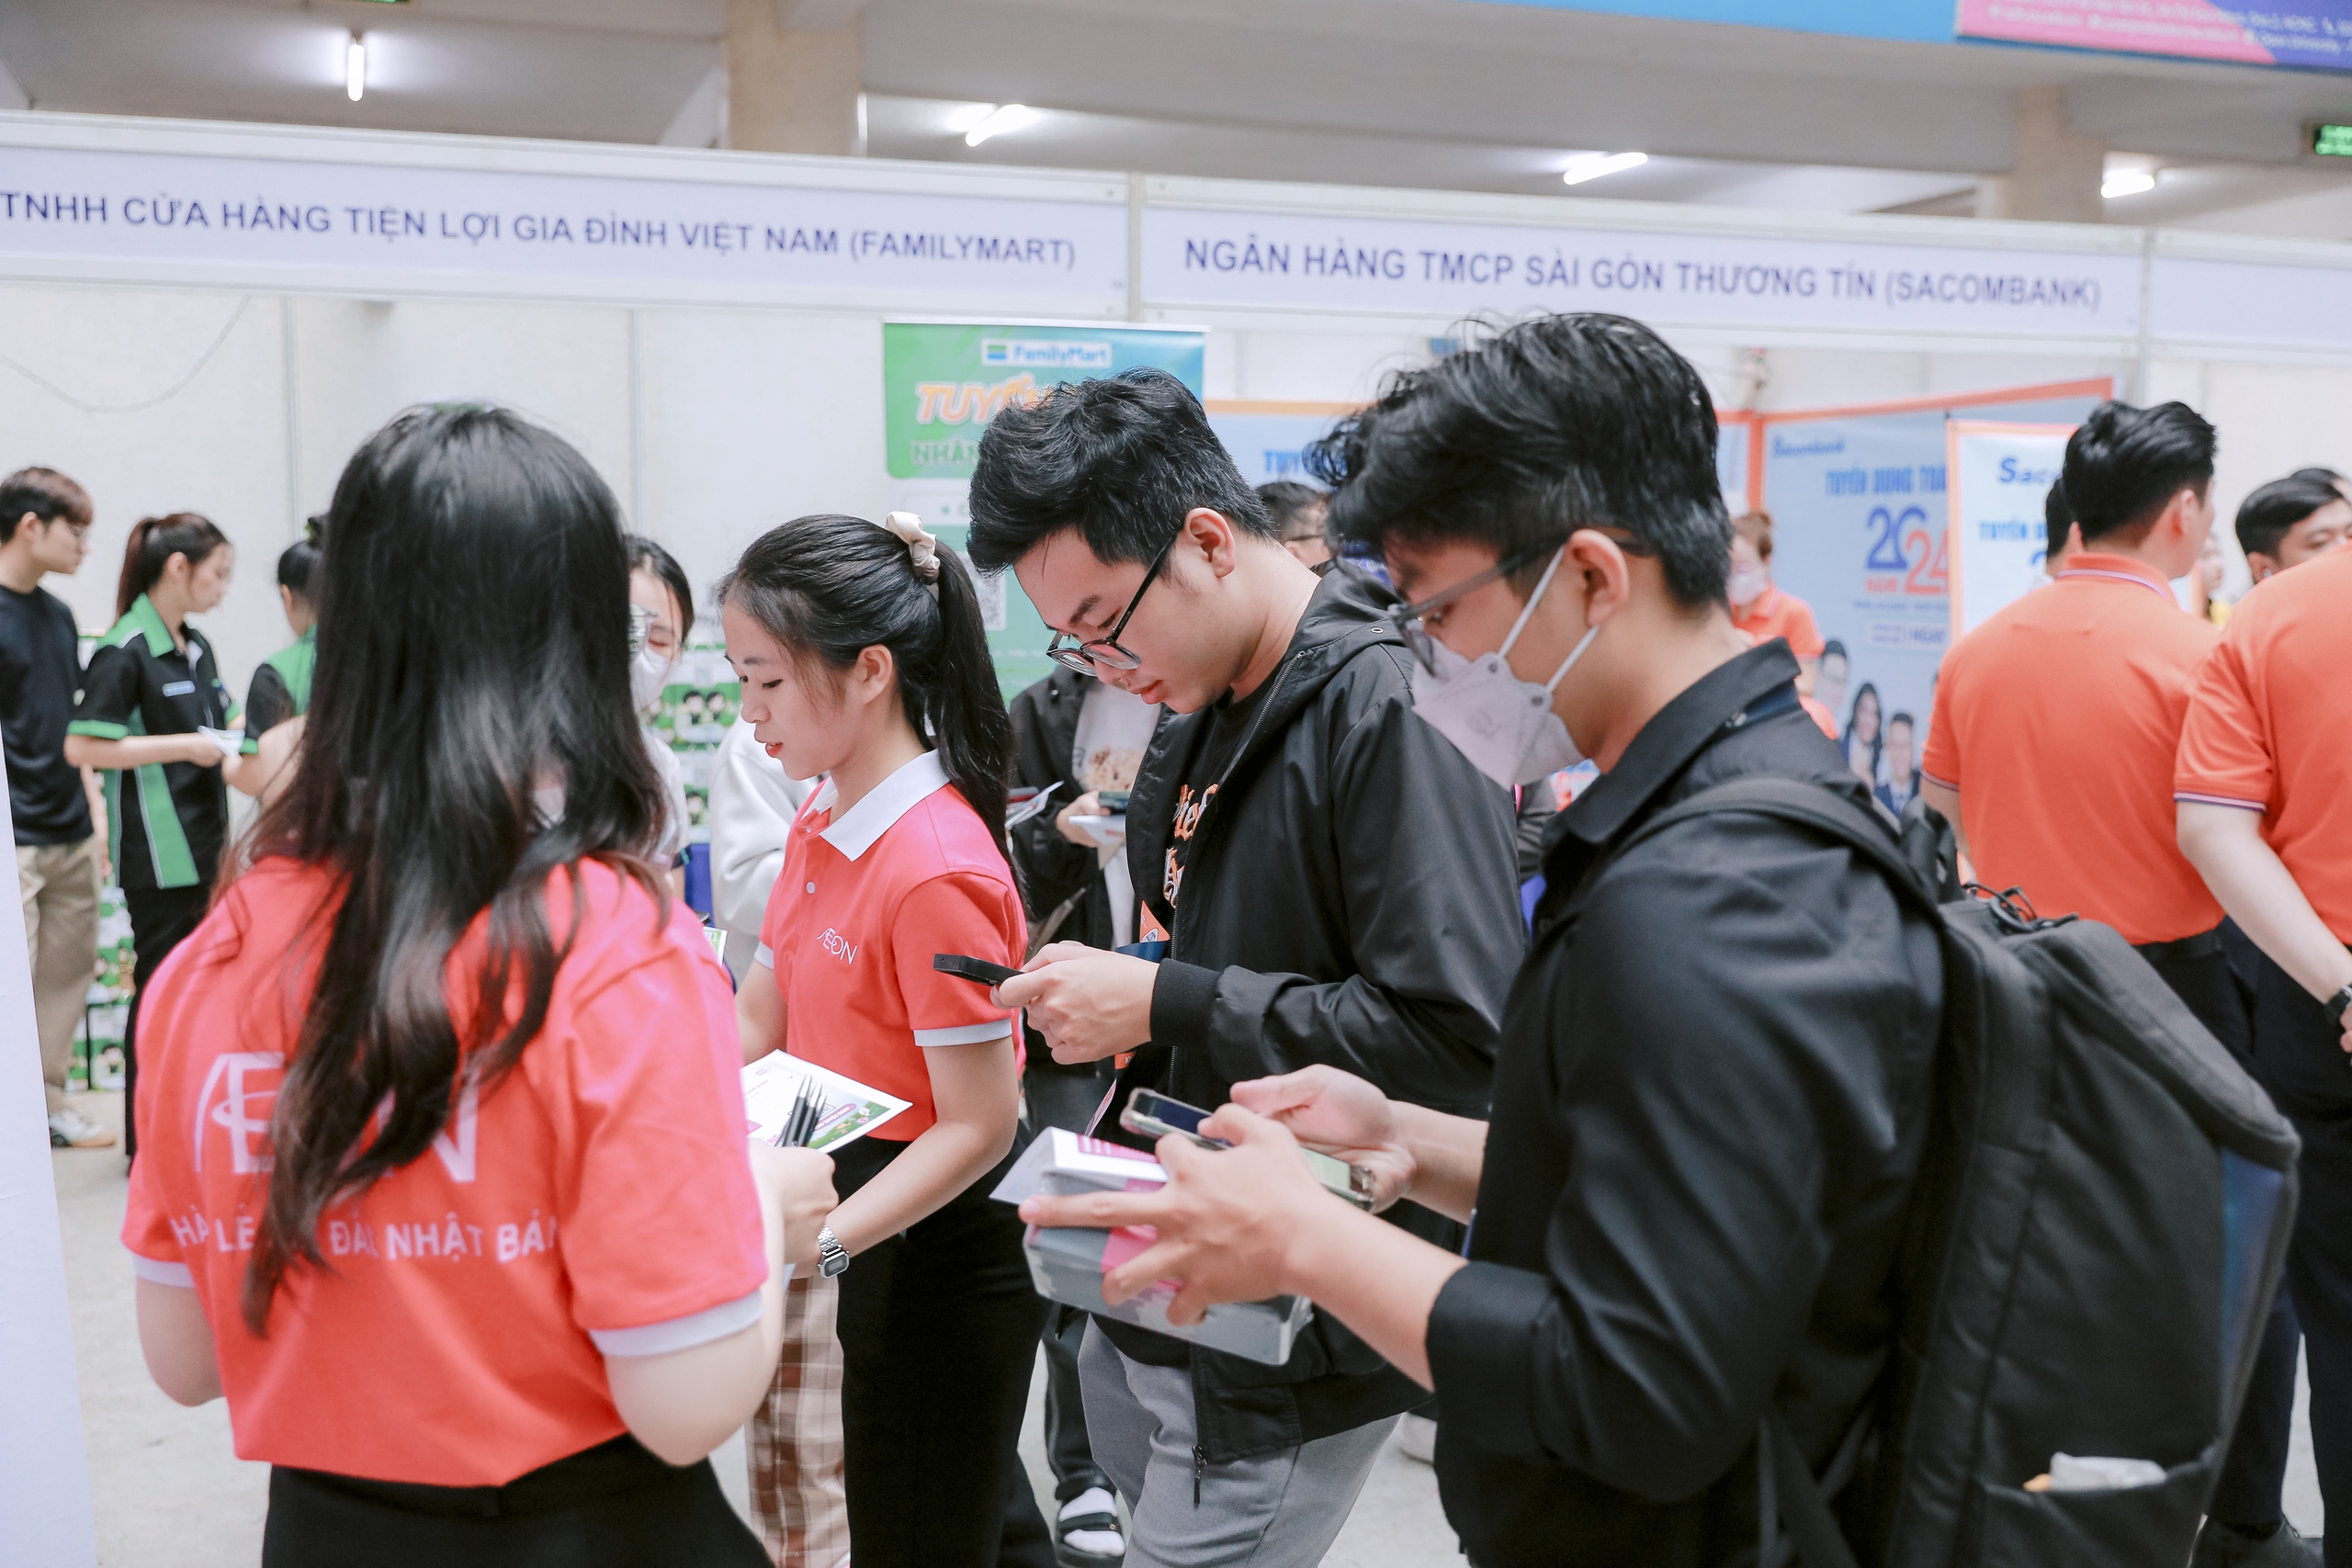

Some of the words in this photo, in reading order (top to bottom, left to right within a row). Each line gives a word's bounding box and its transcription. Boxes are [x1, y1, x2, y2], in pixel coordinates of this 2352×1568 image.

[1, 191, 108, 224] TNHH
[123, 191, 211, 229] CỬA
[222, 196, 331, 234] HÀNG
[345, 206, 426, 243] TIỆN
[441, 211, 500, 245] LỢI
[513, 213, 573, 243] GIA
[585, 210, 667, 248] ĐÌNH
[678, 220, 752, 257] VIỆT
[765, 226, 840, 255] NAM
[850, 228, 1076, 272] (FAMILYMART)
[1185, 233, 1291, 274] NGÂN
[1305, 237, 1406, 279] HÀNG
[1419, 250, 1513, 286] TMCP
[1525, 246, 1579, 288] SÀI
[1592, 251, 1663, 290] GÒN
[1677, 261, 1816, 298] THƯƠNG
[1829, 260, 1875, 299] TÍN
[1885, 270, 2101, 312] (SACOMBANK)
[1014, 344, 1108, 366] FamilyMart
